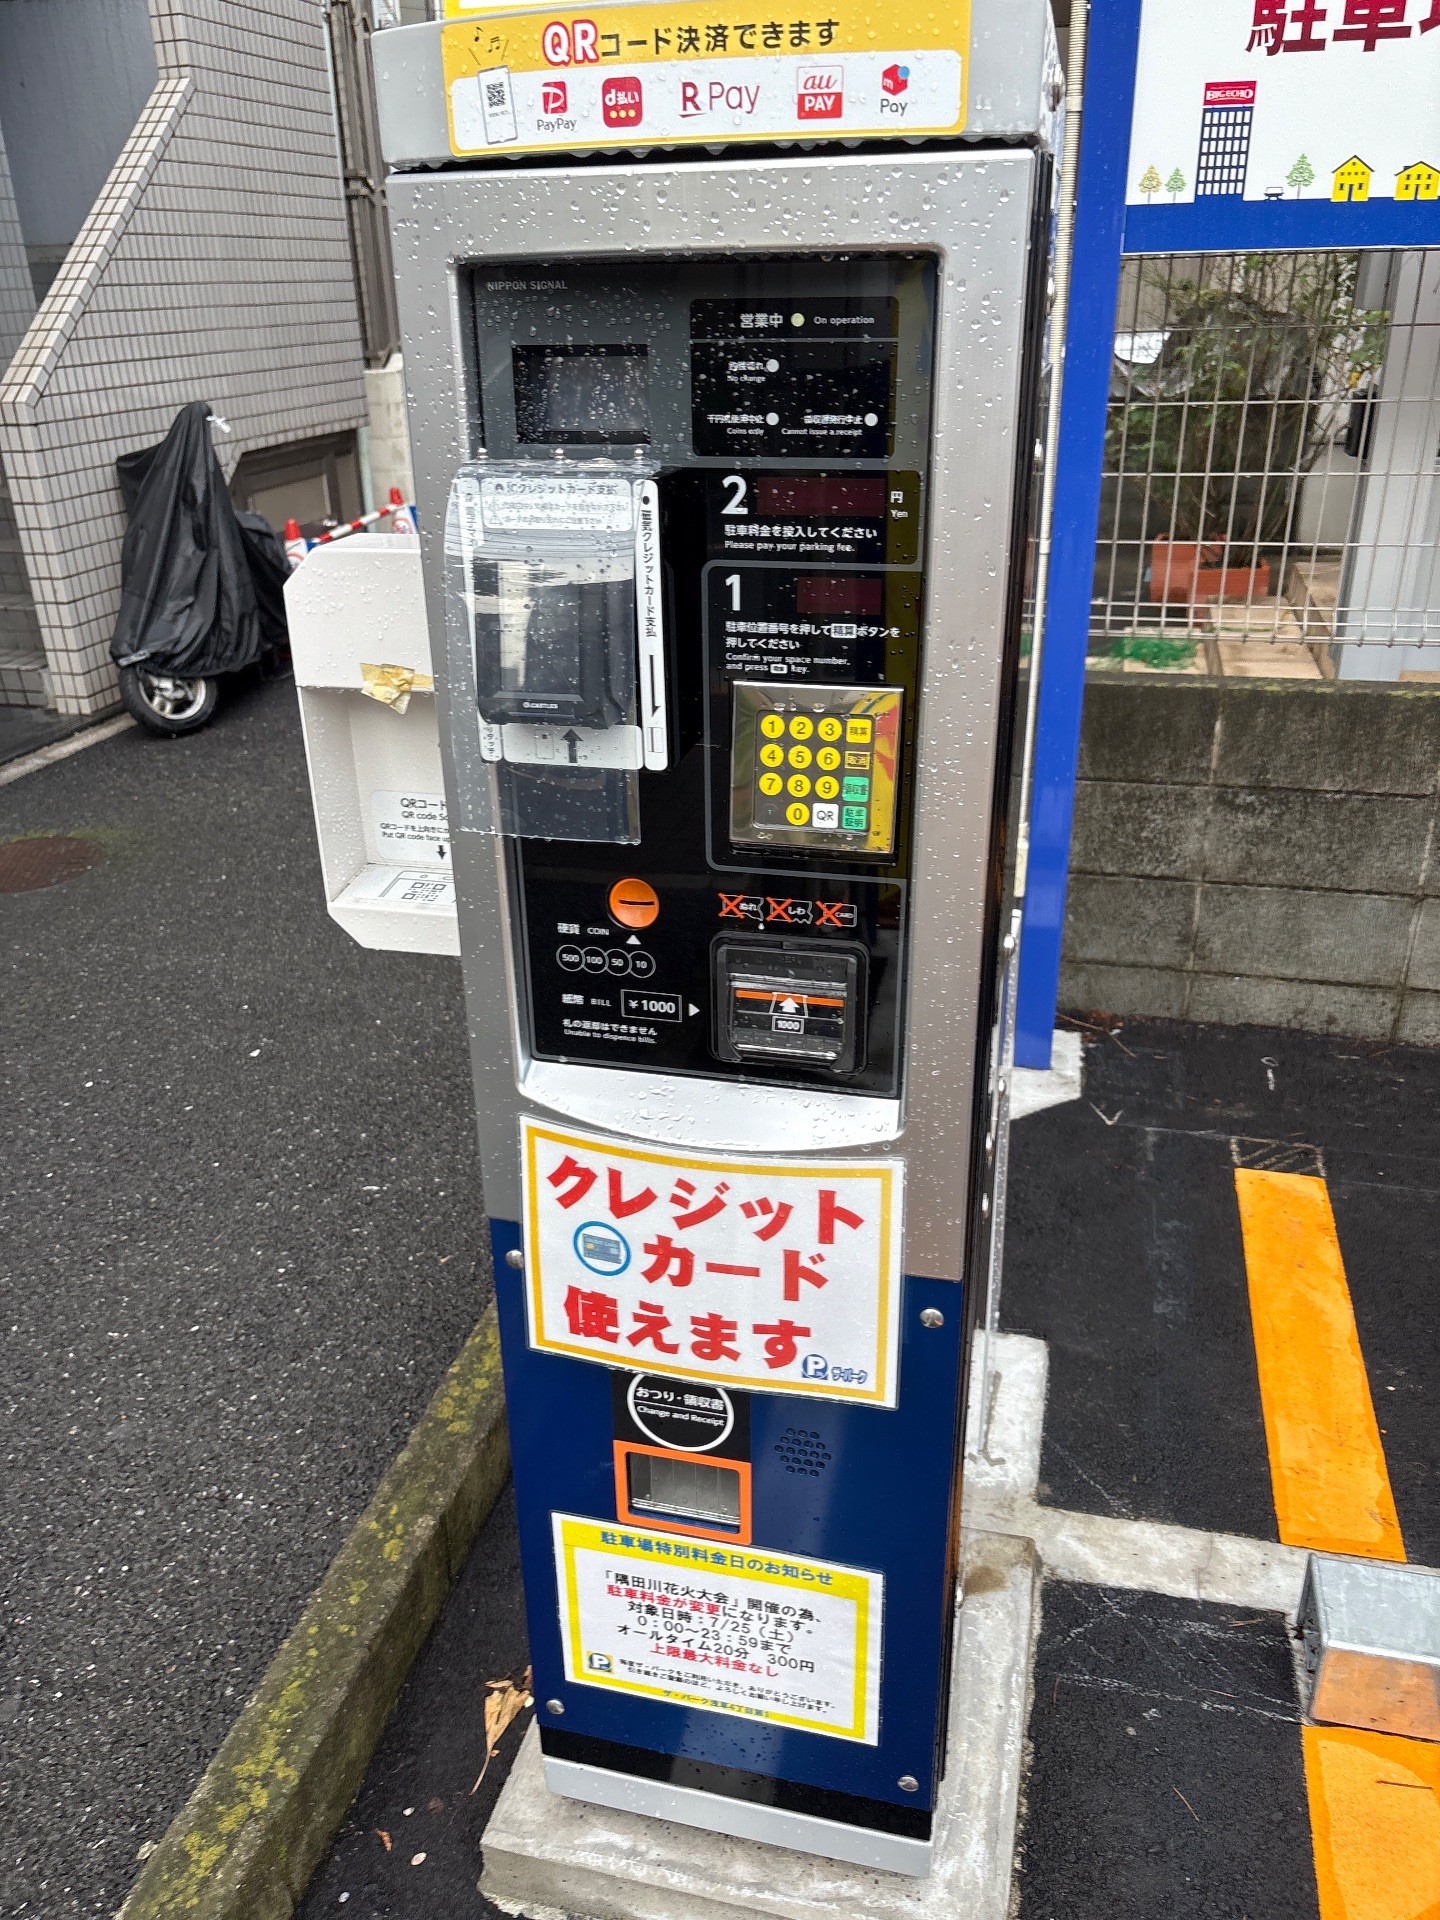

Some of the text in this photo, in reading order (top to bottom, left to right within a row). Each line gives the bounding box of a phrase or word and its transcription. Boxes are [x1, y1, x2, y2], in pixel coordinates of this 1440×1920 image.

[1244, 0, 1440, 56] 駐車
[542, 19, 840, 65] QRコード決済できます
[802, 75, 837, 90] au
[604, 89, 641, 106] d払い
[708, 81, 760, 115] Pay
[803, 94, 836, 112] PAY
[879, 99, 908, 117] Pay
[536, 117, 577, 133] PayPay
[486, 280, 568, 291] NIPPON SIGNAL
[740, 312, 783, 329] 営業中
[813, 315, 875, 327] On operation
[720, 475, 748, 515] 2
[890, 490, 904, 504] 円
[890, 508, 909, 518] Yen
[724, 524, 878, 539] 駐車料金を投入してください
[724, 540, 755, 549] Please
[776, 542, 797, 551] your
[798, 542, 835, 553] parking
[725, 574, 741, 611] 1
[725, 636, 801, 650] 押してください
[725, 652, 761, 662] Confirm
[762, 655, 784, 664] your
[785, 656, 812, 665] space
[725, 662, 743, 670] and
[744, 664, 769, 673] press
[768, 721, 835, 736] 1 2 3
[766, 749, 834, 765] 4 5 6
[766, 778, 832, 793] 7 8 9
[402, 811, 415, 819] QR
[416, 812, 437, 820] code
[793, 808, 835, 821] 0 QR
[587, 927, 610, 936] COIN
[561, 953, 648, 969] 500 100 50 10
[590, 998, 612, 1007] BILL
[546, 1154, 866, 1246] クレジット
[640, 1233, 830, 1302] カード
[563, 1284, 813, 1370] 使えます
[636, 1405, 726, 1427] Change and Receipt
[600, 1530, 834, 1587] 駐車場特別料金日のお知らせ
[603, 1569, 822, 1624] 「隅田川花火大会」開催の為、
[605, 1583, 814, 1635] 駐車料金が変更になります。
[616, 1624, 816, 1674] オールタイム20分 300円
[649, 1642, 780, 1678] 上限最大料金なし
